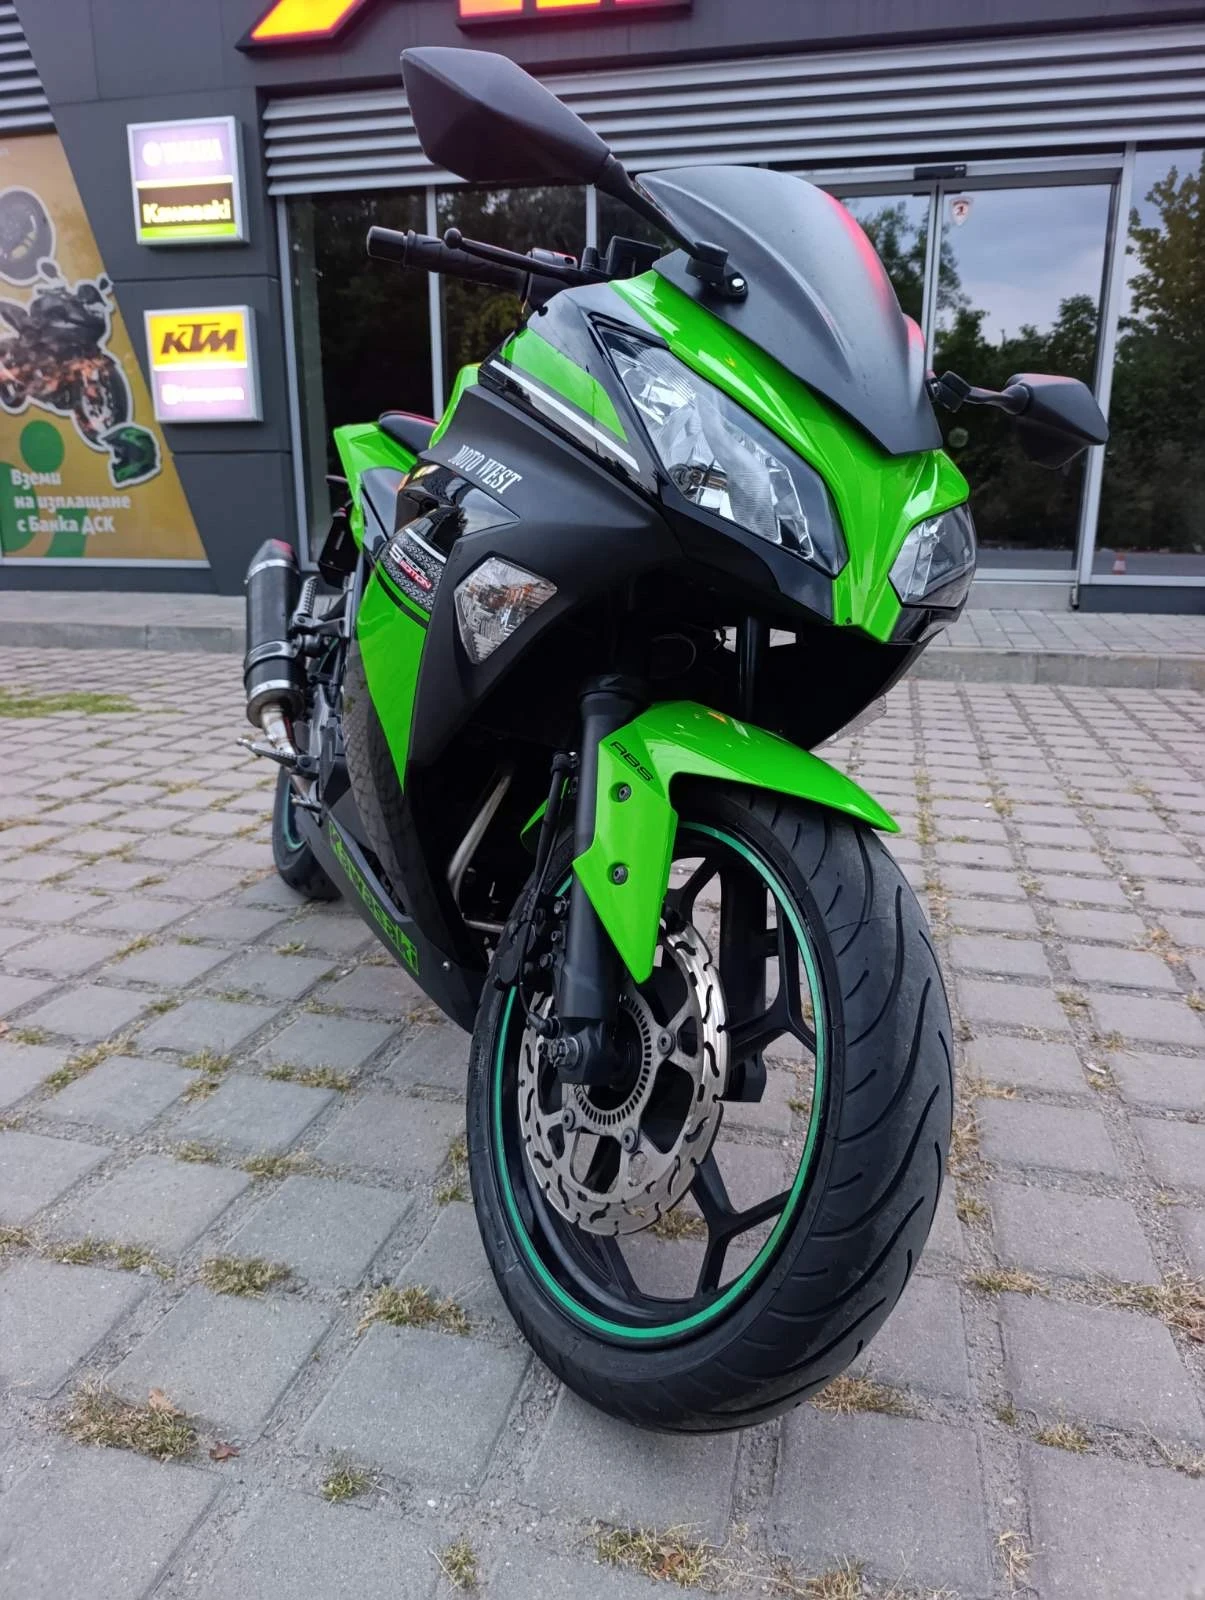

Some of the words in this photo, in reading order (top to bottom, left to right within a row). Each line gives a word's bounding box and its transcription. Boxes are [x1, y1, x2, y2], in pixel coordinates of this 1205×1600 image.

[160, 322, 238, 355] KTM
[10, 468, 62, 490] Вземи
[447, 444, 486, 472] MOTO
[475, 458, 523, 494] WEST
[14, 495, 36, 509] на
[37, 495, 132, 513] изплащане
[27, 515, 79, 533] Банка
[81, 515, 116, 535] ДСК
[610, 741, 654, 781] ABS
